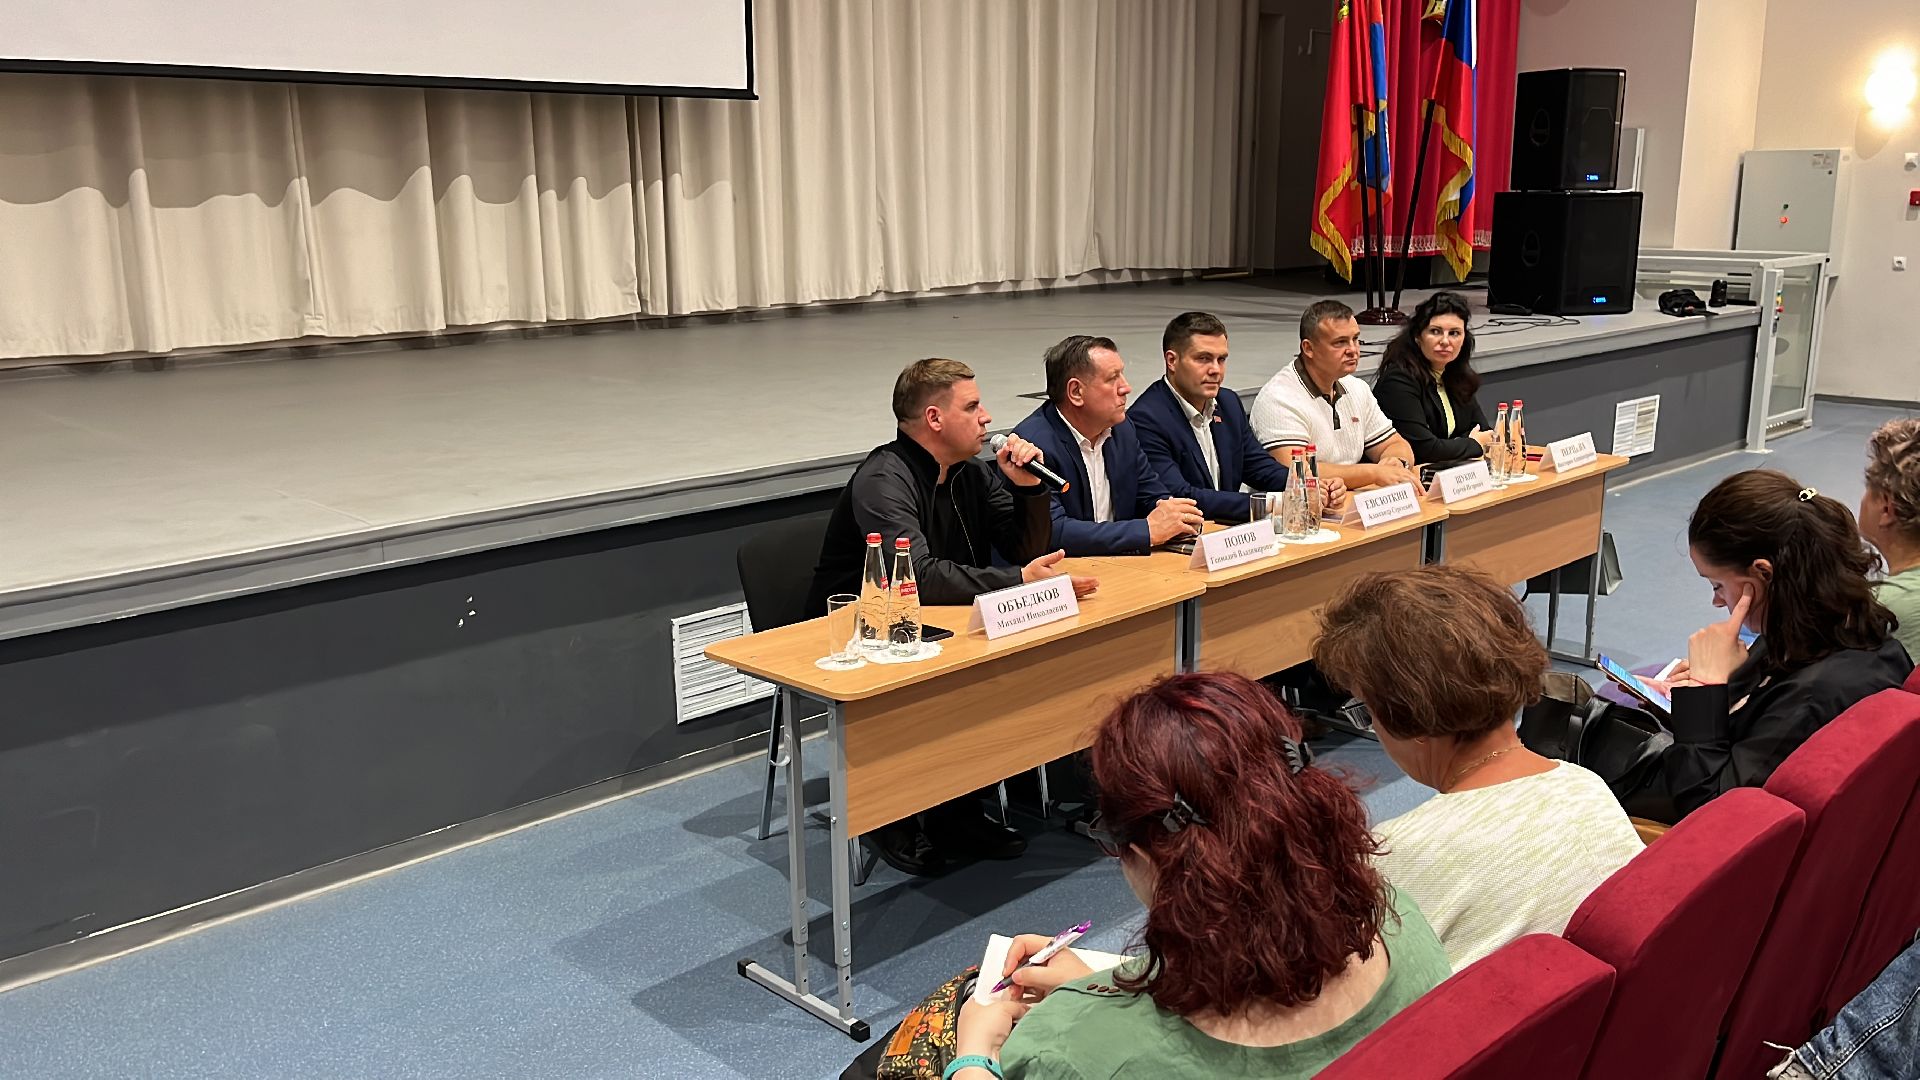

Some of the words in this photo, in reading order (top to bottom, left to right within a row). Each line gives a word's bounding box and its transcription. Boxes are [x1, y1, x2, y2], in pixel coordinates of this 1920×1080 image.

[1364, 490, 1408, 509] ЕВСЮТКИН
[1225, 532, 1256, 548] ПОПОВ
[997, 587, 1060, 614] ОБЪЕДКОВ
[997, 615, 1026, 629] Михаил
[1026, 604, 1068, 620] Николаевич
